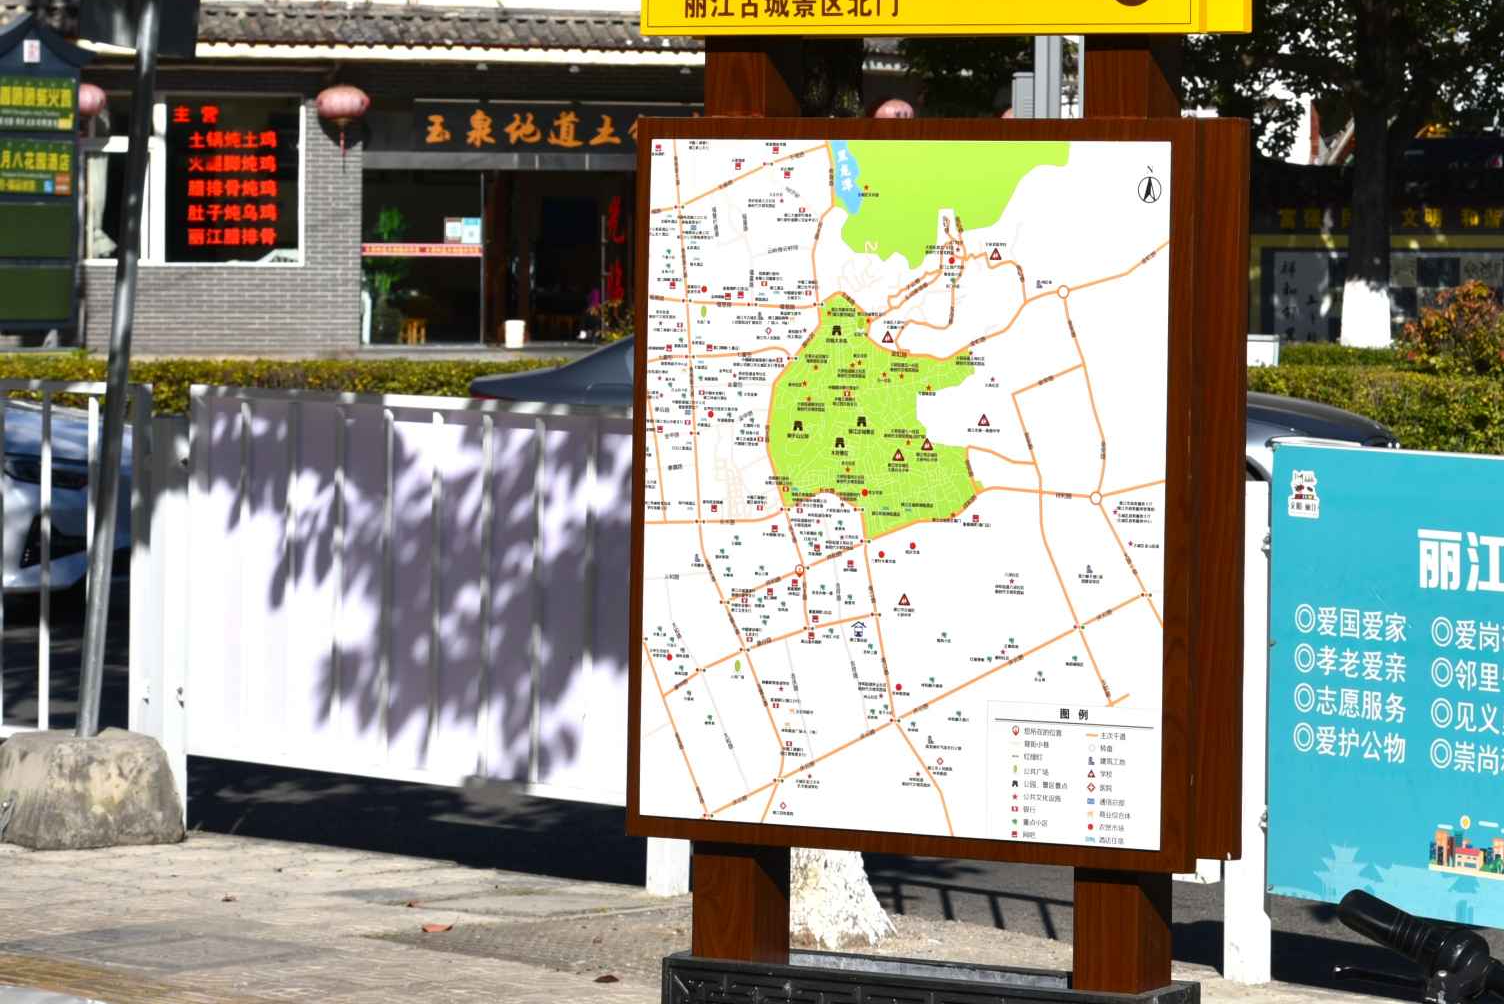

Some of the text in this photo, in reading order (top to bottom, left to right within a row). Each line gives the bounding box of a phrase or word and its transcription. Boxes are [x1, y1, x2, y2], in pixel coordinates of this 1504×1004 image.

[425, 109, 639, 147] 玉泉地道土
[1400, 205, 1446, 229] 文明
[1316, 605, 1408, 643] 爱国爱家
[1315, 644, 1408, 684] 孝老爱亲
[1060, 708, 1089, 720] 图例
[1315, 685, 1407, 724] 志愿服务
[1315, 725, 1407, 765] 爱护公物
